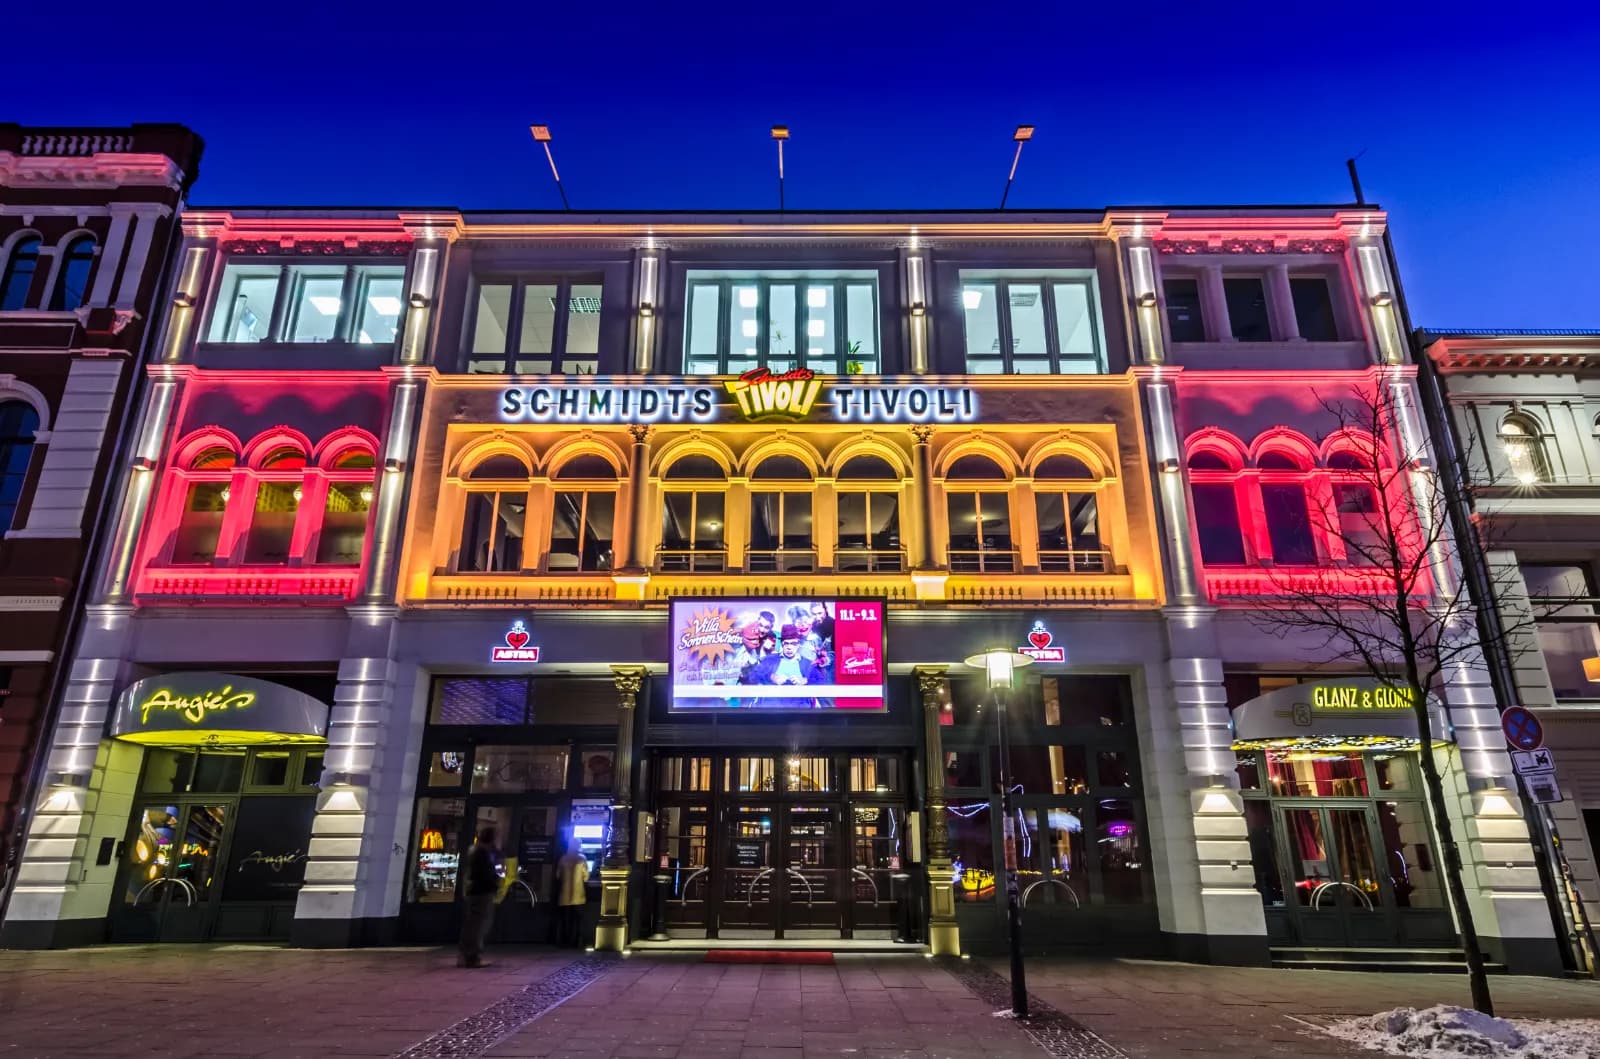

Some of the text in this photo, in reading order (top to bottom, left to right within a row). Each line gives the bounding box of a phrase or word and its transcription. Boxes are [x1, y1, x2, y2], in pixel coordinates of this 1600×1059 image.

[503, 389, 713, 418] SCHMIDTS
[724, 380, 823, 416] TIVOLI
[835, 388, 973, 416] TIVOLI
[693, 616, 720, 634] Villa
[1314, 687, 1358, 708] GLANZ
[1363, 691, 1372, 708] &
